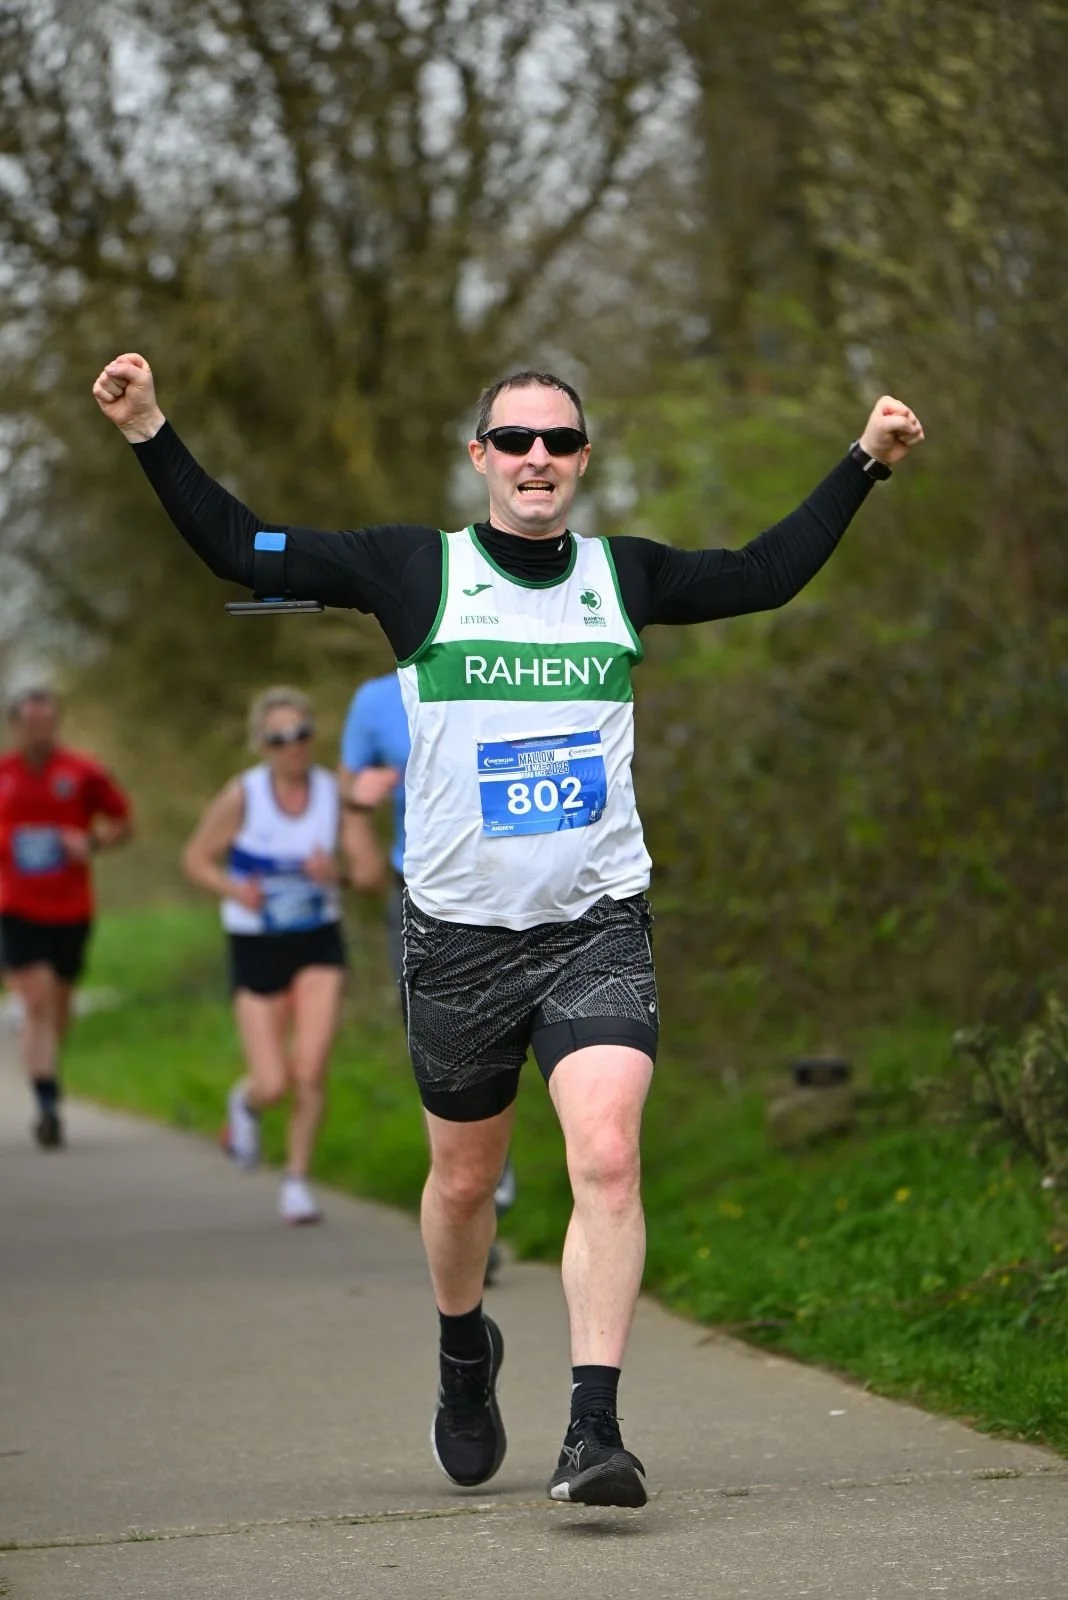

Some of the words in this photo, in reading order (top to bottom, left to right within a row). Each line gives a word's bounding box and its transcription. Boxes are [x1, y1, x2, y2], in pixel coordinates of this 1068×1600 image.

[460, 615, 500, 625] LEYDENS
[465, 655, 613, 686] RAHENY
[518, 750, 555, 766] MALLOW
[547, 761, 569, 776] 2026
[507, 776, 583, 815] 802
